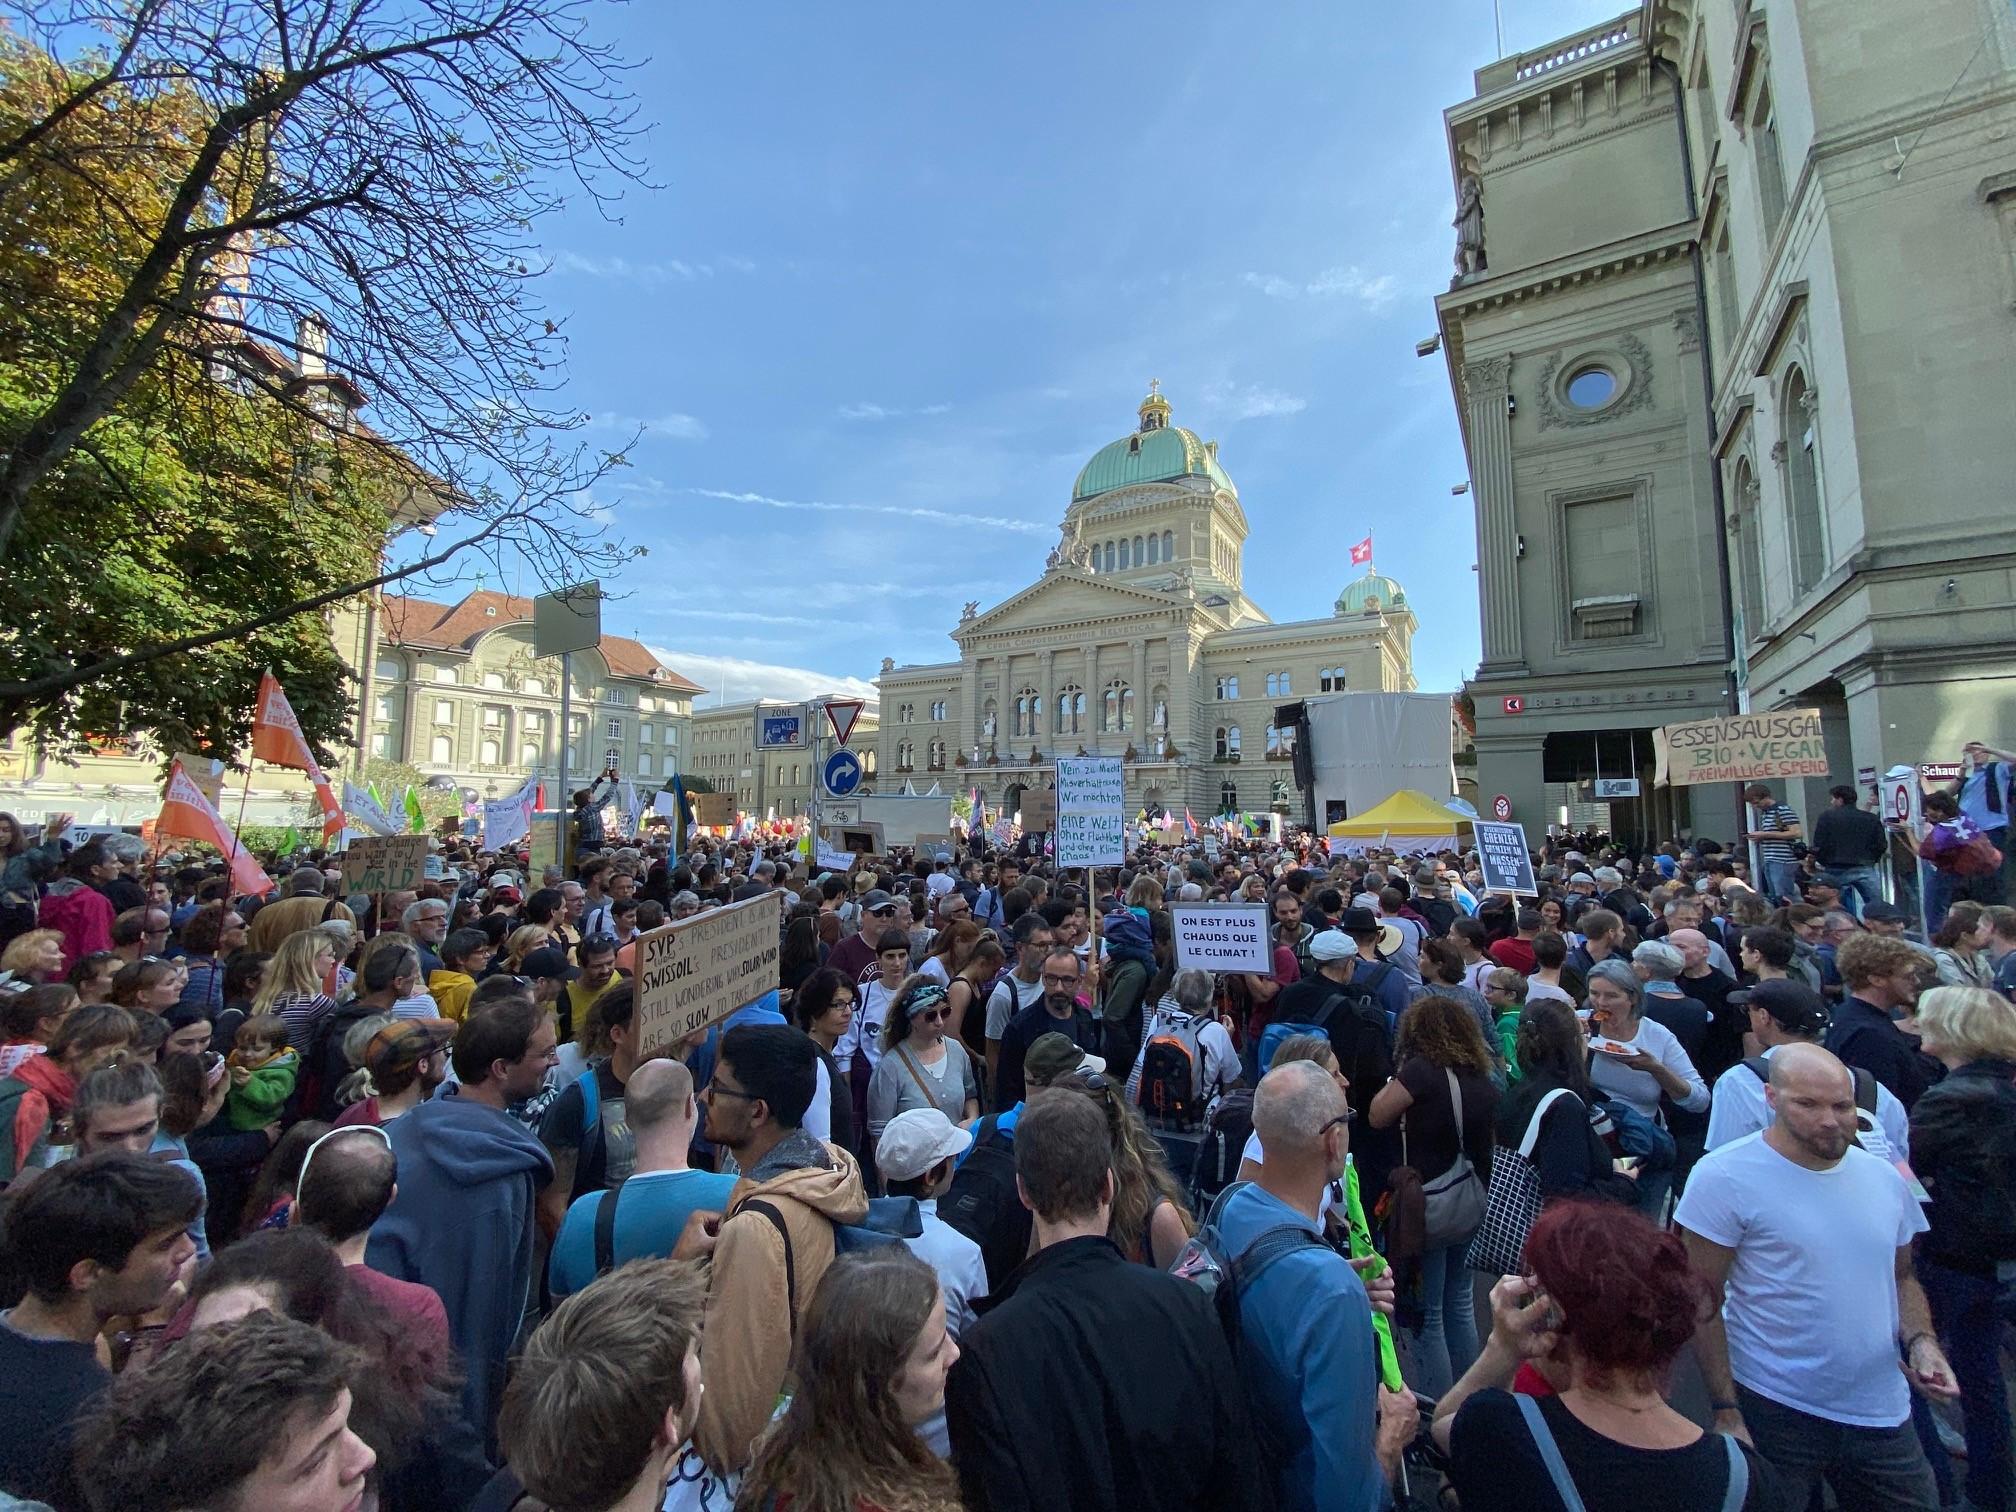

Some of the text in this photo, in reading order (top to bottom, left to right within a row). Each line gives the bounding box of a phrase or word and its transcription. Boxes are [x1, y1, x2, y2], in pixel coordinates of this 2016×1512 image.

[772, 708, 792, 717] ZONE
[1692, 746, 1732, 767] BIO
[1060, 762, 1080, 775] Nein
[1085, 767, 1096, 775] zu
[1687, 764, 1774, 782] FREIWILLIGE
[1060, 792, 1079, 804] Wir
[1061, 815, 1085, 829] eine
[1091, 815, 1119, 829] Welt
[1483, 832, 1519, 846] GRENZEN
[1060, 844, 1075, 852] und
[346, 868, 415, 892] WORLD
[691, 911, 744, 945] PRESIDENT
[1181, 917, 1256, 928] ON EST PLUS
[1183, 932, 1258, 943] CHAUDS QUE
[1188, 947, 1202, 956] LE
[1205, 948, 1248, 958] CLIMAT
[641, 1000, 671, 1026] STILL
[675, 973, 724, 1009] WONDERING
[641, 1028, 664, 1055] ARE
[670, 1018, 682, 1040] SO
[685, 1005, 710, 1033] SLOW
[717, 997, 728, 1014] TO
